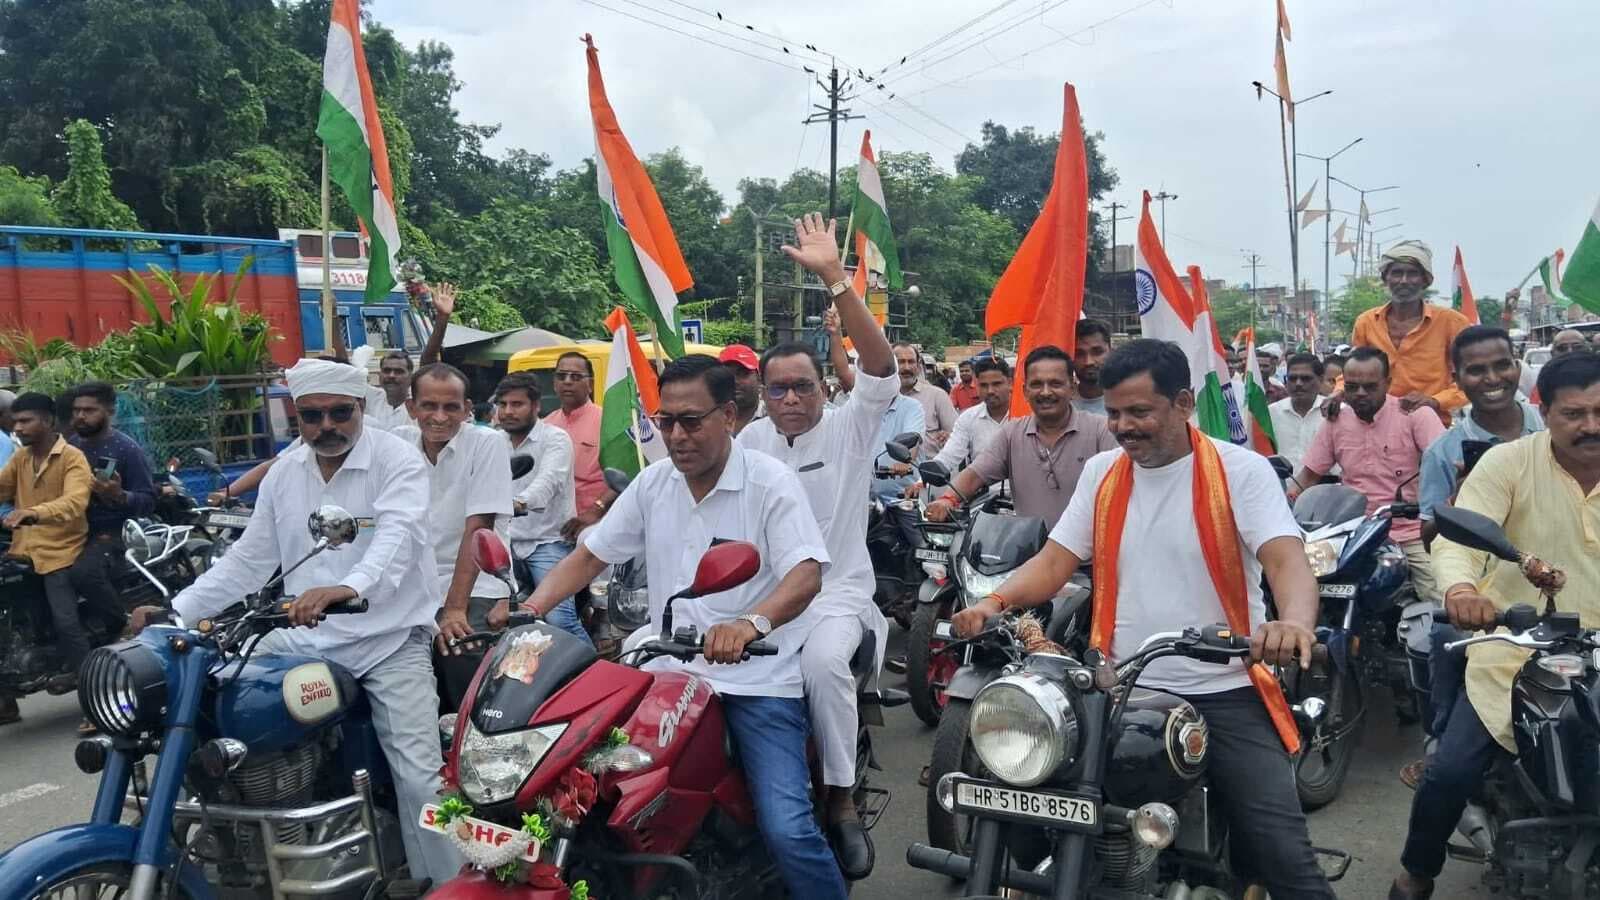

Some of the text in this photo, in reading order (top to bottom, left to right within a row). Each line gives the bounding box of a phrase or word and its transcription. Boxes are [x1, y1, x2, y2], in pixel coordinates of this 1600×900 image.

[300, 679, 328, 694] ROYAL
[300, 687, 332, 706] ENFIELD
[974, 785, 993, 807] HR
[1048, 798, 1090, 821] 8576
